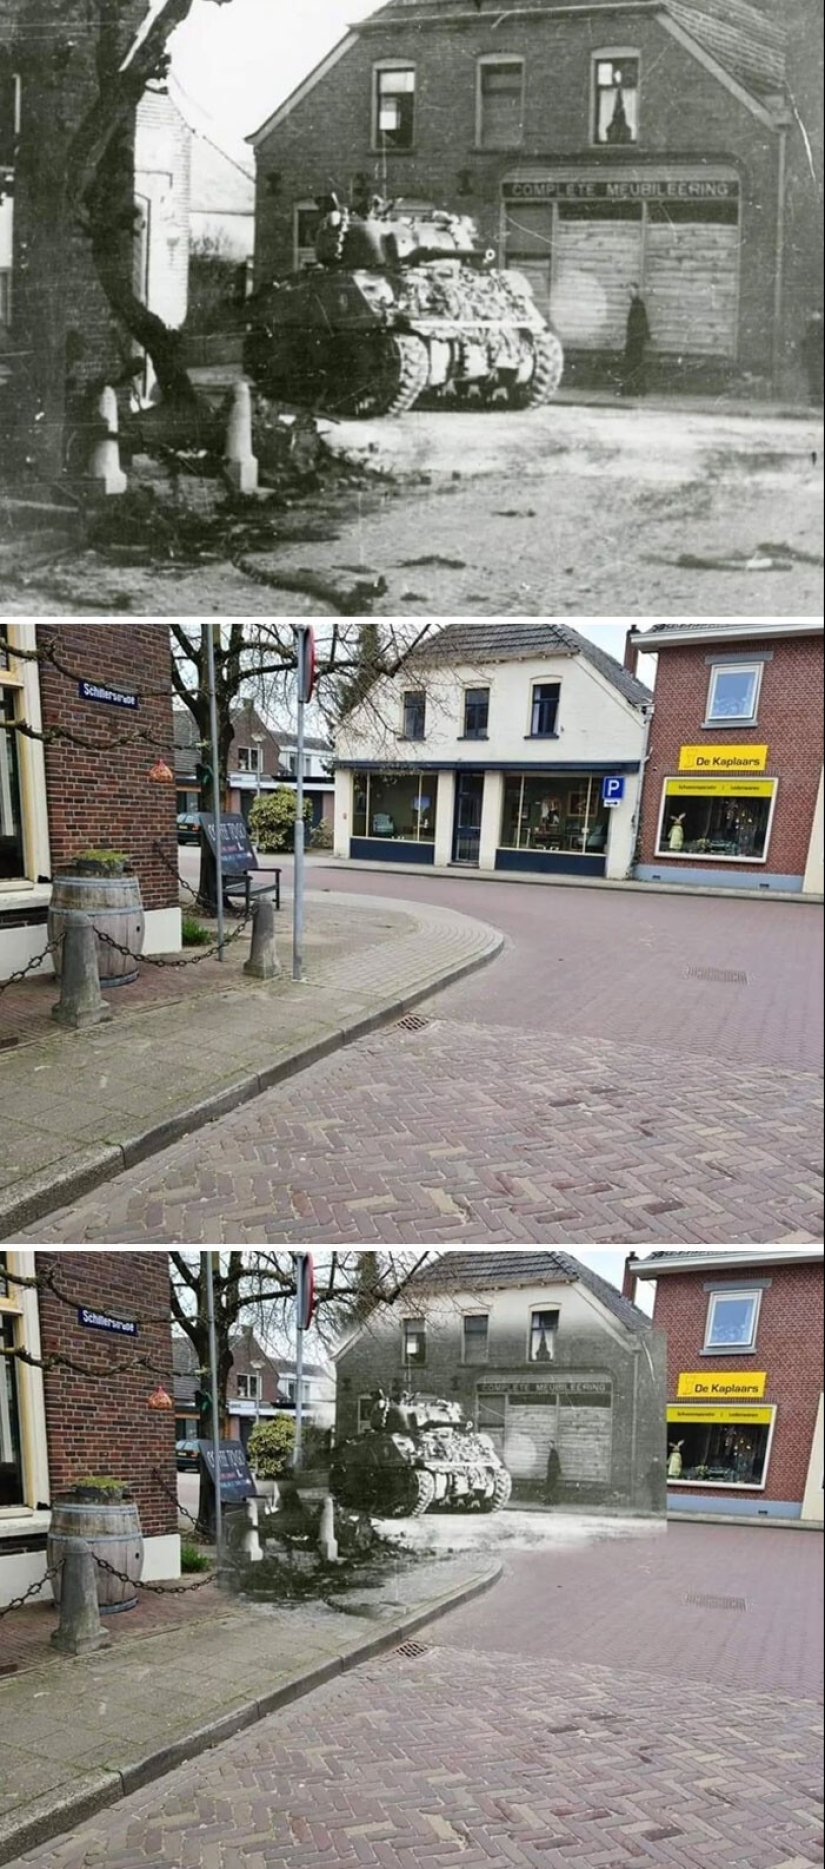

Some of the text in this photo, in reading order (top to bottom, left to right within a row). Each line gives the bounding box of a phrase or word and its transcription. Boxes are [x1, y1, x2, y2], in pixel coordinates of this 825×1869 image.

[512, 183, 729, 197] COMPLETE MEUBILEERING
[696, 756, 760, 768] De Kaplaars
[607, 780, 620, 797] P
[695, 1383, 759, 1395] De Kaplaars
